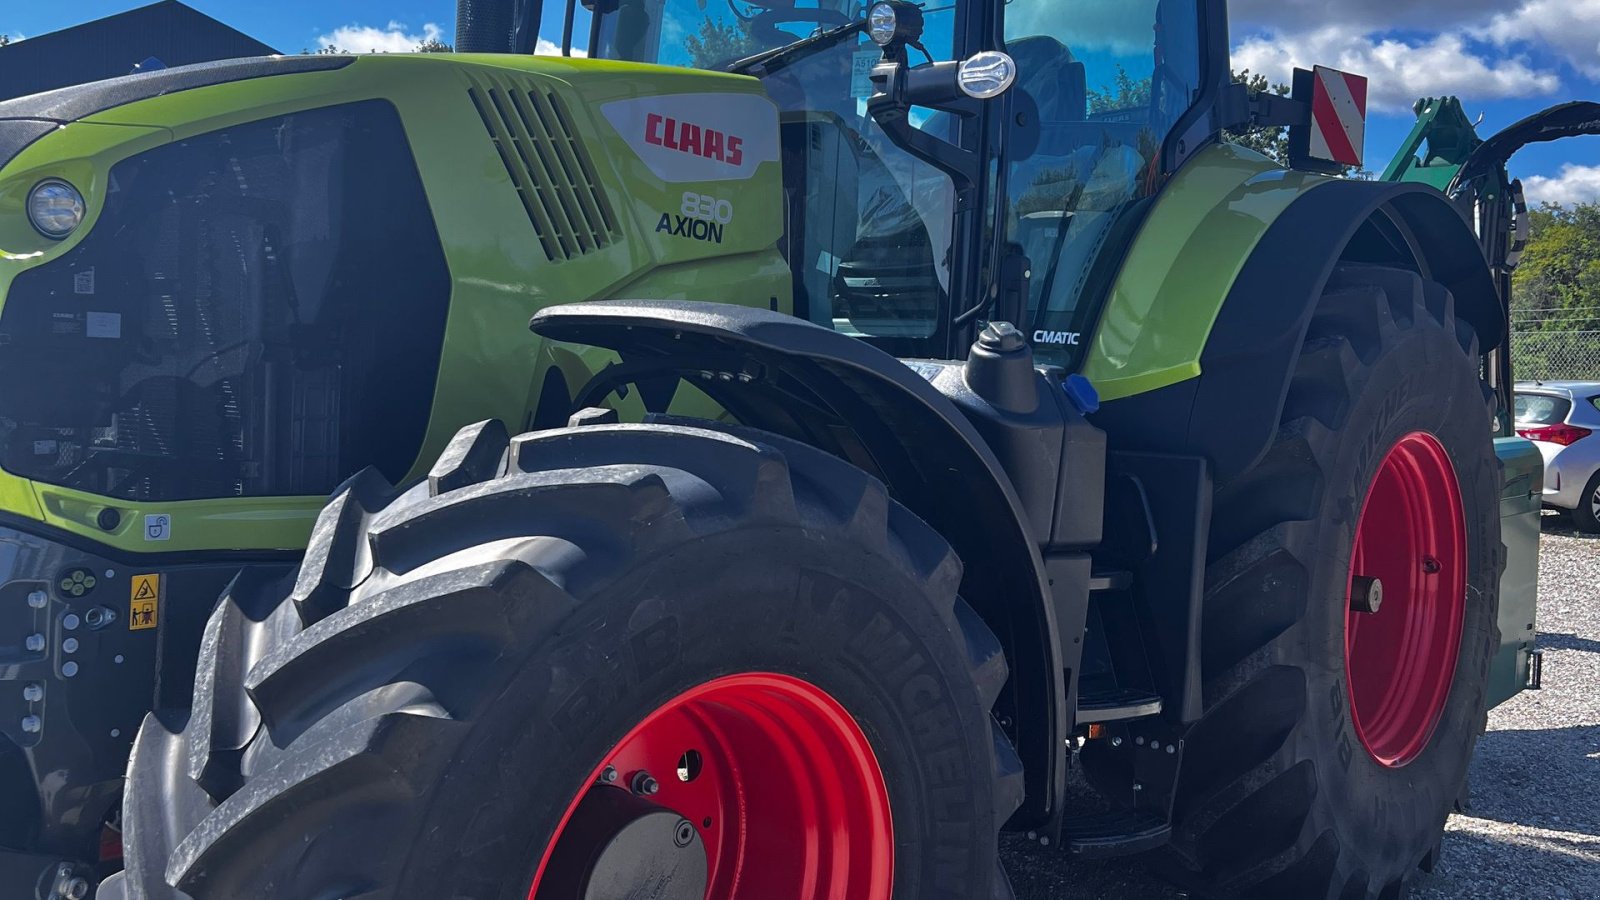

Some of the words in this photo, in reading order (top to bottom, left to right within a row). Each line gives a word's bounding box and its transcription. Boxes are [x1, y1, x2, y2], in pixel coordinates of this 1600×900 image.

[644, 112, 743, 166] CLAAS
[680, 191, 733, 225] 830
[655, 212, 723, 244] AXION
[1033, 329, 1080, 345] CMATIC
